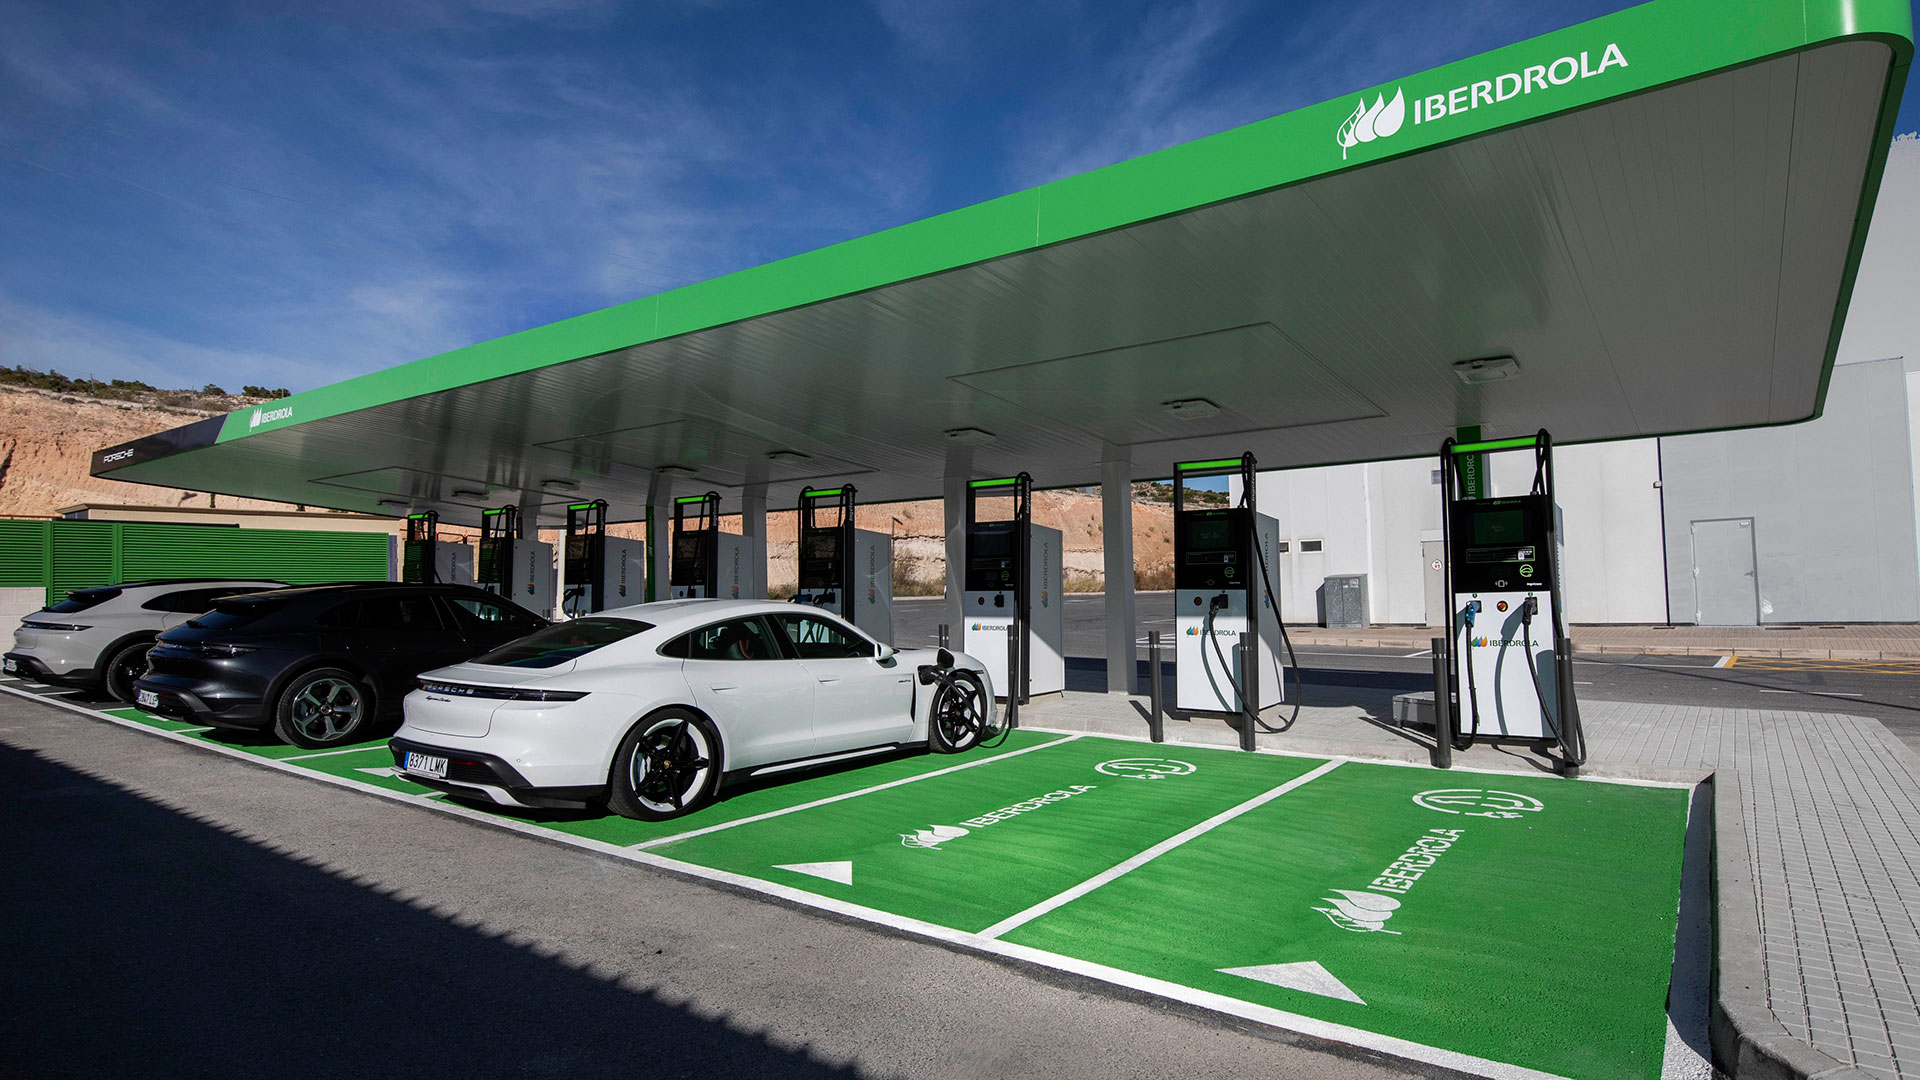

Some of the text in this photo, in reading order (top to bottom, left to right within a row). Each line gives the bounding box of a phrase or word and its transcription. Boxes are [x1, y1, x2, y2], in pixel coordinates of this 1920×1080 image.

[1414, 43, 1629, 125] IBERDROLA
[261, 406, 293, 424] IBERDROLA
[103, 448, 134, 463] PORSCHE
[1466, 454, 1476, 495] IBERDRO
[408, 753, 429, 770] 8371
[959, 784, 1098, 828] IBERDROLA
[1367, 828, 1465, 894] IBERDROLA
